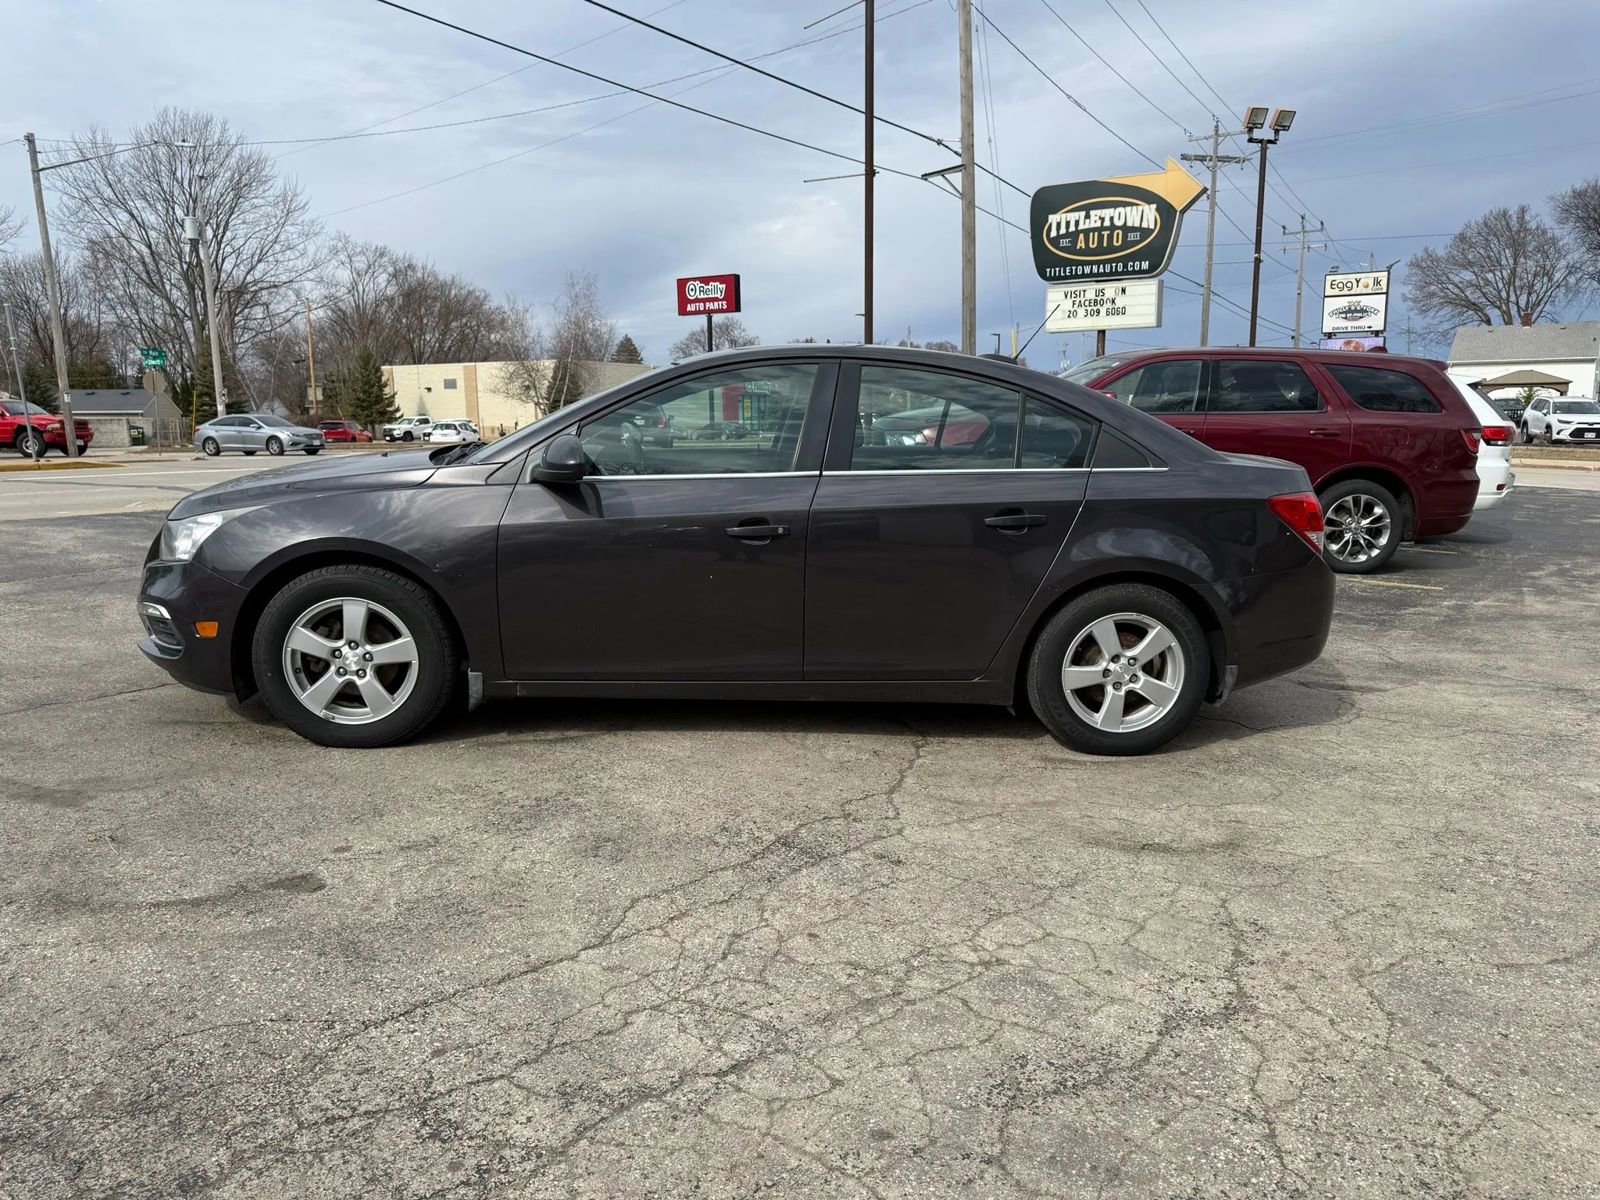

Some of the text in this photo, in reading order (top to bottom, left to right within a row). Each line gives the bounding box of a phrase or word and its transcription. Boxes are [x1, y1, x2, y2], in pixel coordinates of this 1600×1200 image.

[1048, 204, 1157, 238] TITLETOWN
[1076, 229, 1123, 250] AUTO
[1046, 261, 1149, 277] TITLETOWNAUTO.COM
[686, 281, 726, 299] O'Reilly
[1064, 289, 1087, 299] VISIT
[1095, 288, 1106, 298] US
[687, 300, 728, 312] AUTO PARTS
[1084, 307, 1101, 317] 309
